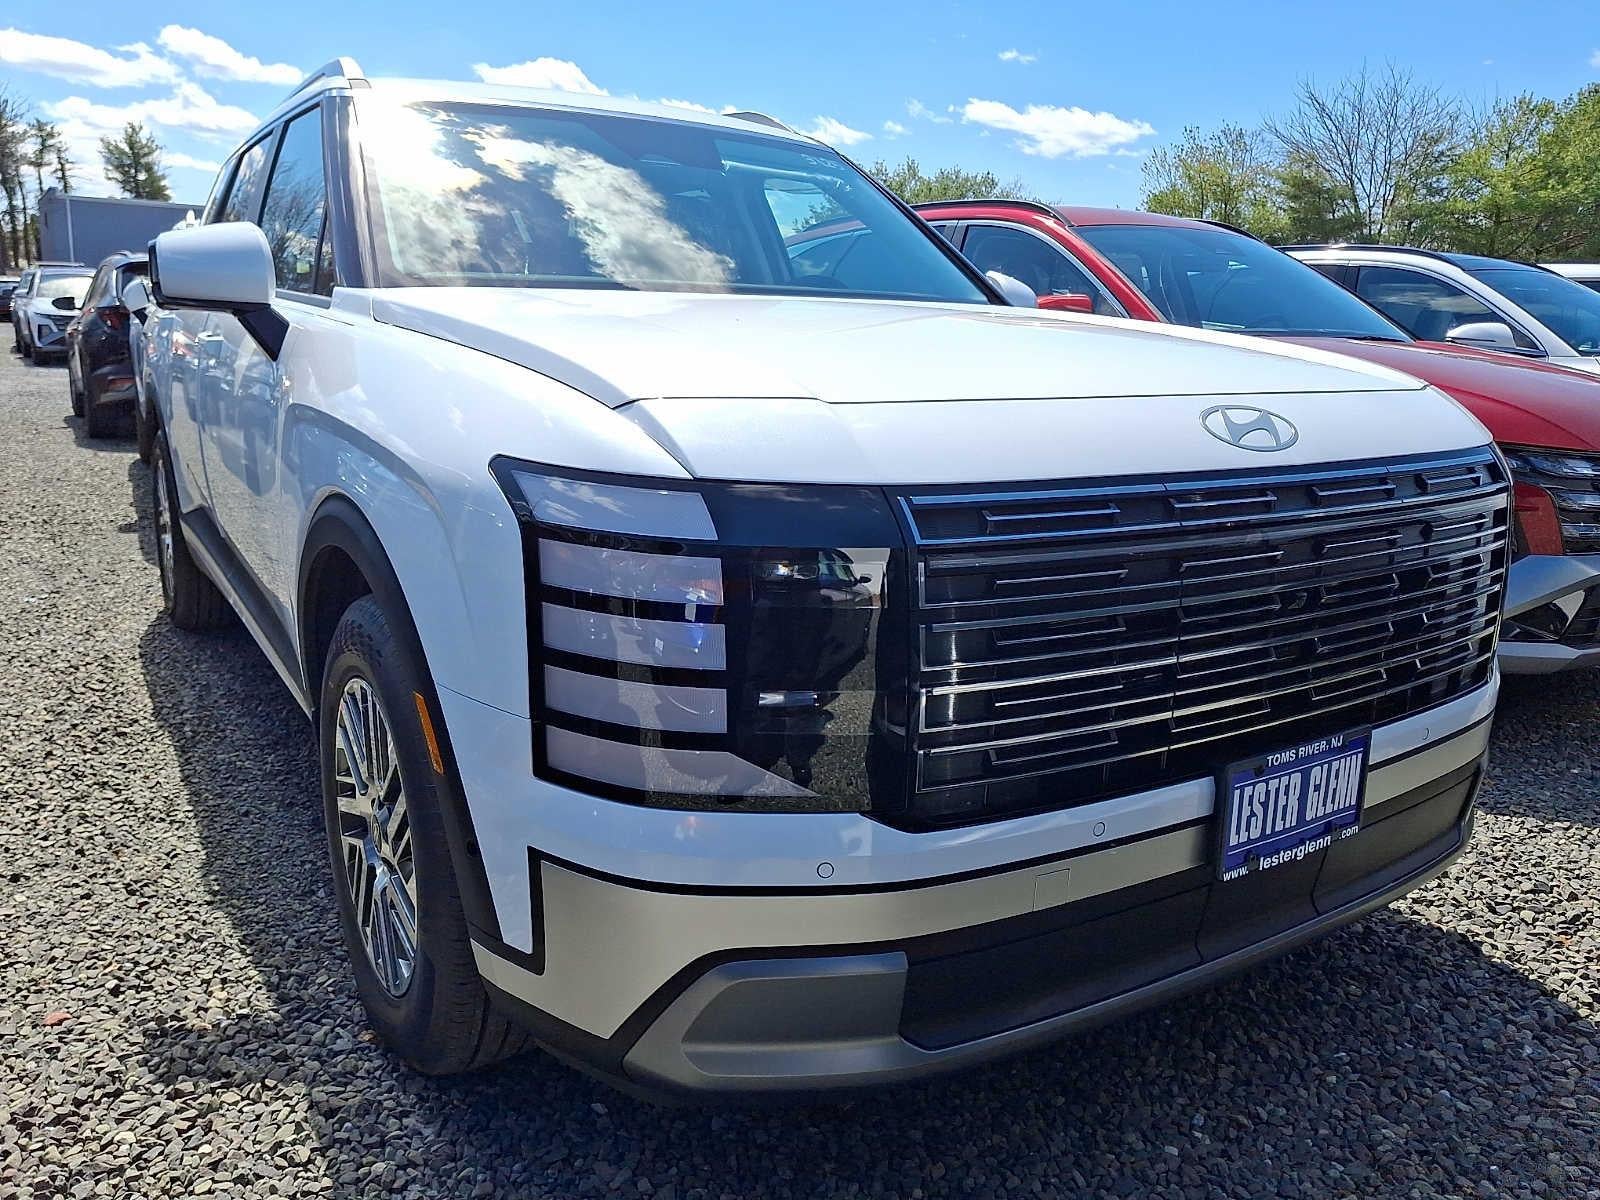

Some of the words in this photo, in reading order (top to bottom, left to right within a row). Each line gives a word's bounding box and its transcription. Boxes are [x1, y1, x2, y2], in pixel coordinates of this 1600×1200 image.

[1267, 749, 1296, 767] TOMS
[1299, 741, 1329, 758] RIVER,
[1331, 735, 1343, 749] NJ
[1229, 772, 1302, 846] LESTER
[1306, 753, 1363, 821] GLENN
[1259, 835, 1331, 871] lesterglenn
